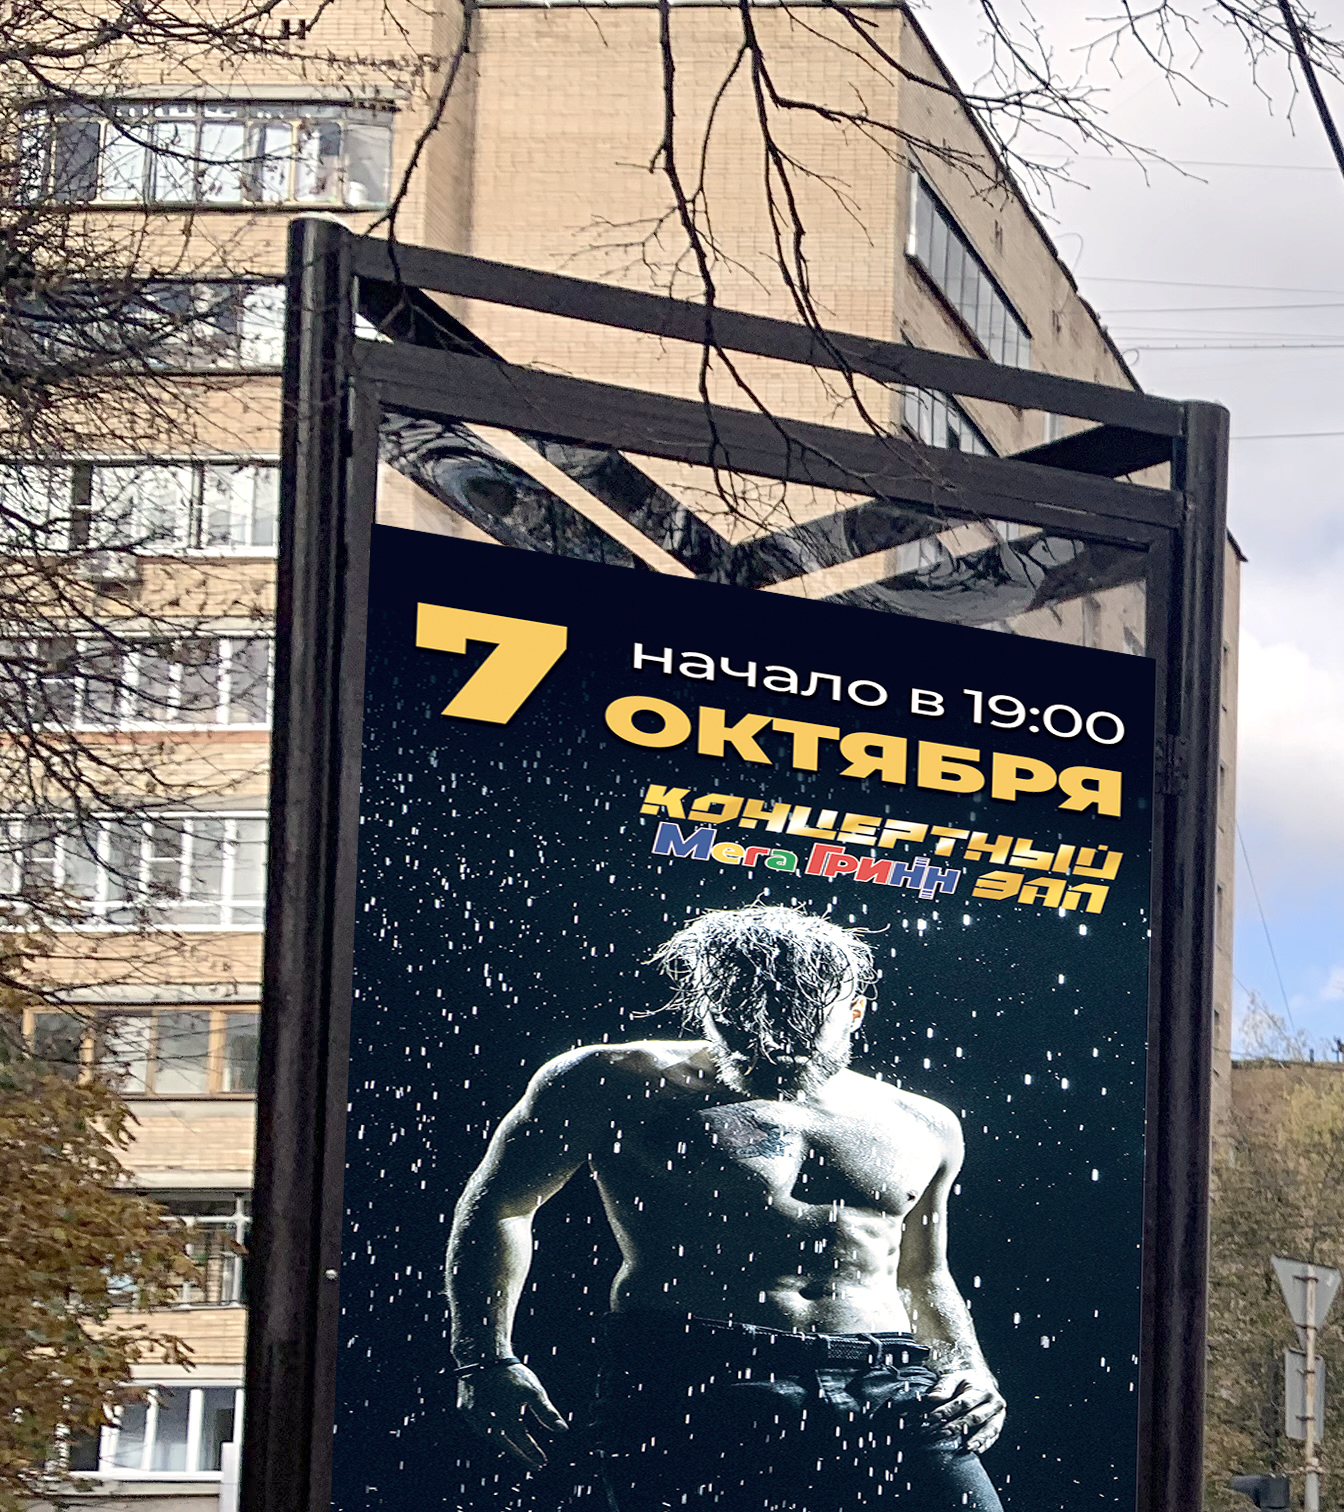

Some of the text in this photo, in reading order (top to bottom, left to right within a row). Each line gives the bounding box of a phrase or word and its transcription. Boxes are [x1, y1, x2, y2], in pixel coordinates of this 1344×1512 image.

[415, 602, 568, 725] 7
[632, 642, 1125, 746] начало в 19:00
[604, 694, 1123, 818] ОКТЯБРЯ
[639, 784, 1124, 881] КОНЦЕРТНЫЙ
[651, 821, 797, 872] Мега
[972, 870, 1110, 915] ЗАЛ
